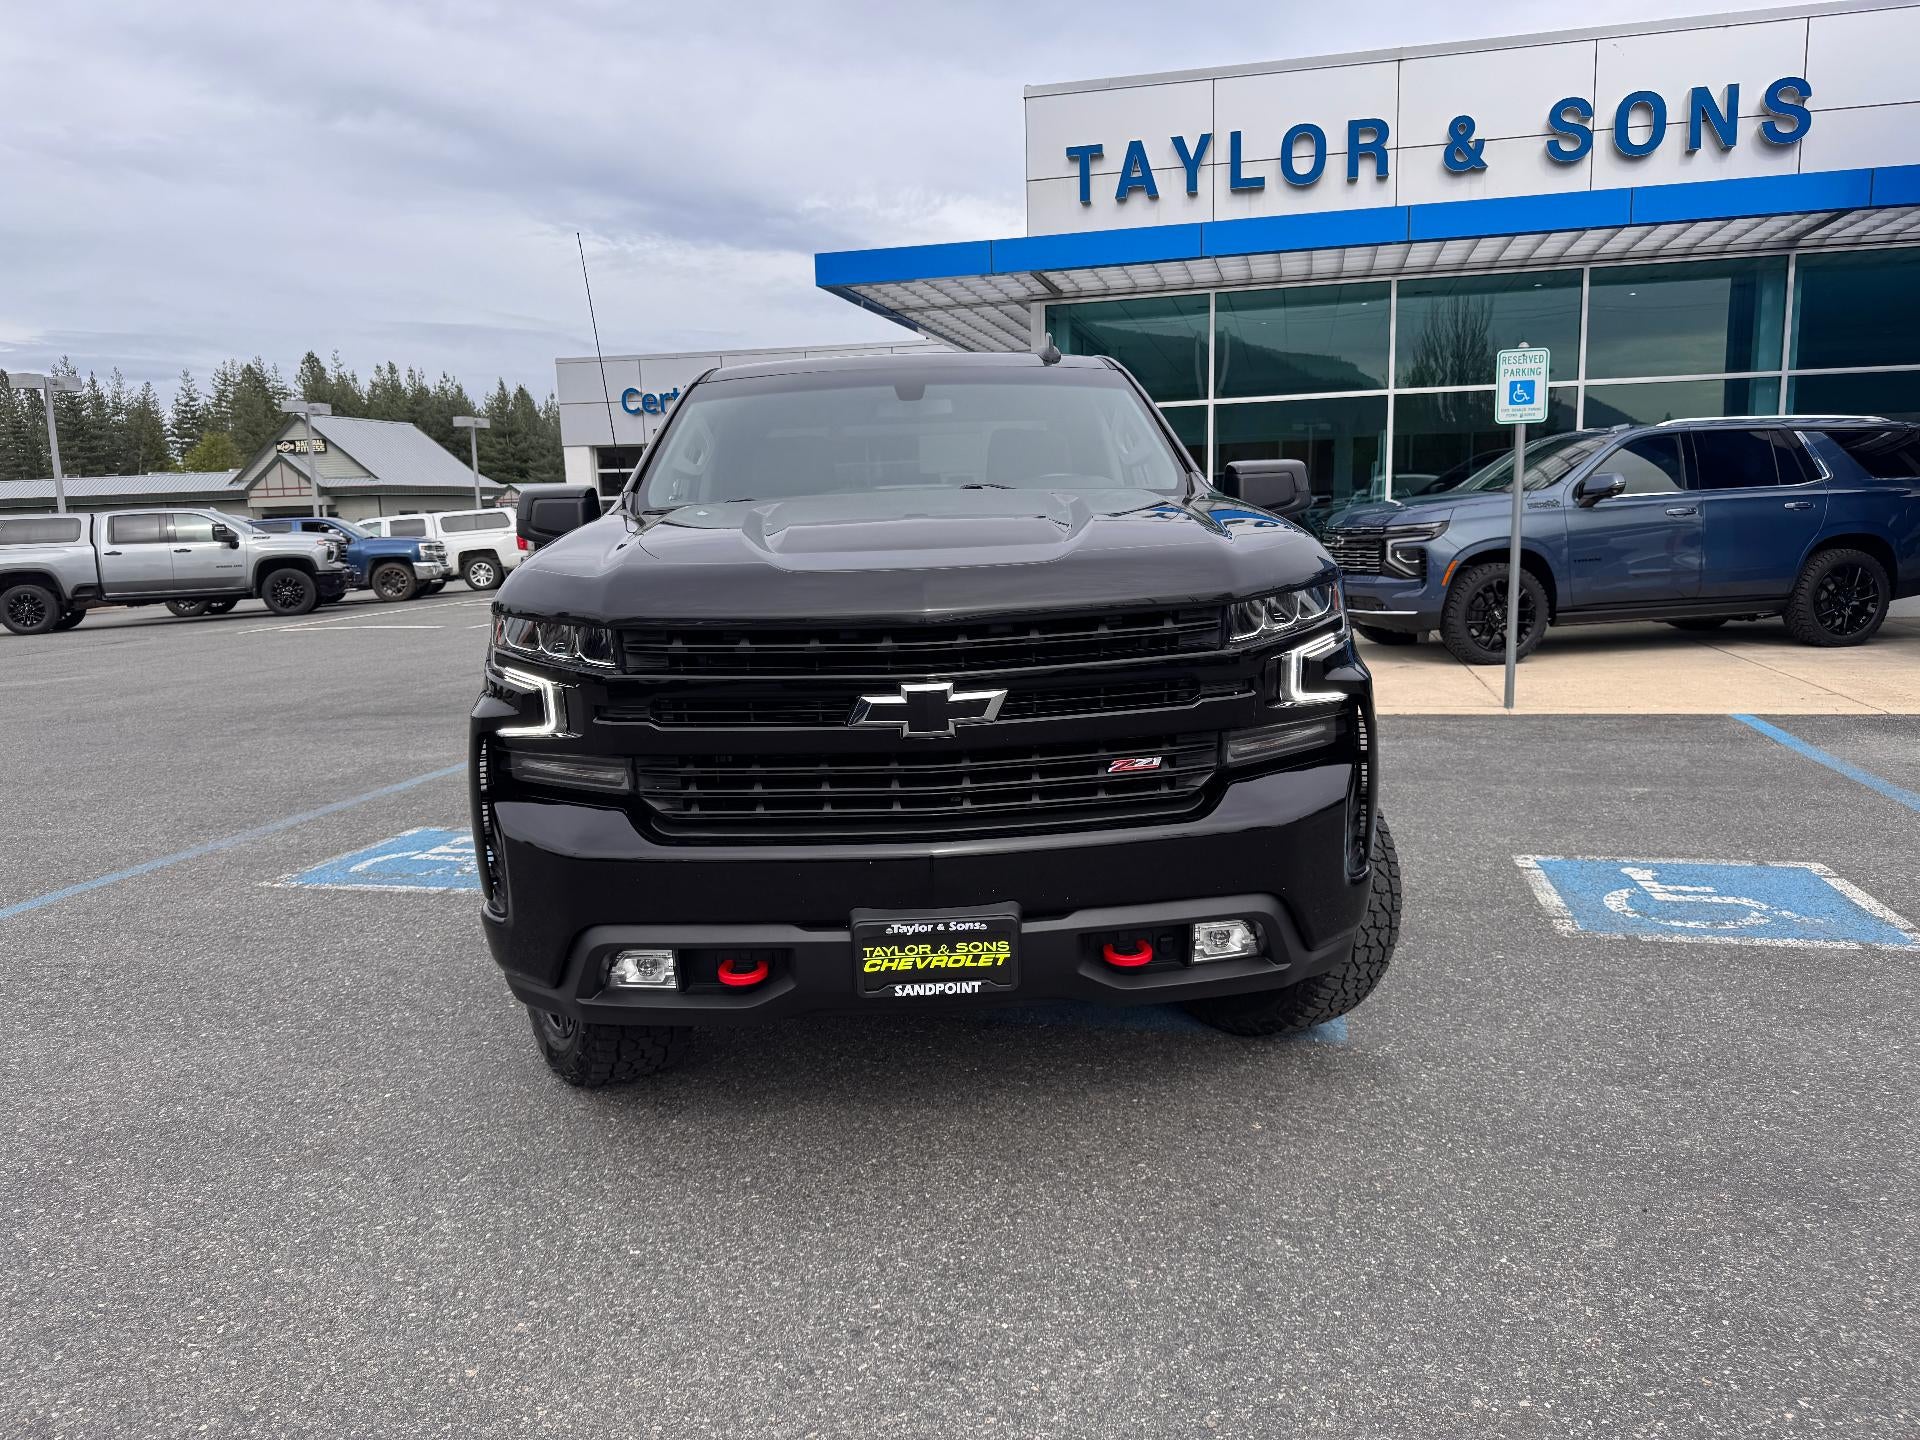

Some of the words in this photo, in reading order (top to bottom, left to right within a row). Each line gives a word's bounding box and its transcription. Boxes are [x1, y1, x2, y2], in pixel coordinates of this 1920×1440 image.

[1066, 117, 1390, 206] TAYLOR
[1443, 114, 1489, 174] &
[1546, 76, 1813, 163] SONS
[1501, 354, 1545, 366] RESERVED
[1503, 367, 1542, 378] PARKING
[621, 384, 687, 416] Cert
[294, 439, 325, 447] NATRAL
[891, 923, 934, 936] Taylor
[936, 923, 945, 931] &
[949, 921, 980, 931] Sons
[863, 944, 932, 958] TAYLOR
[937, 943, 950, 956] &
[955, 940, 1010, 953] SONS
[863, 953, 1011, 973] CHEVROLET
[894, 981, 982, 997] SANDPOINT
